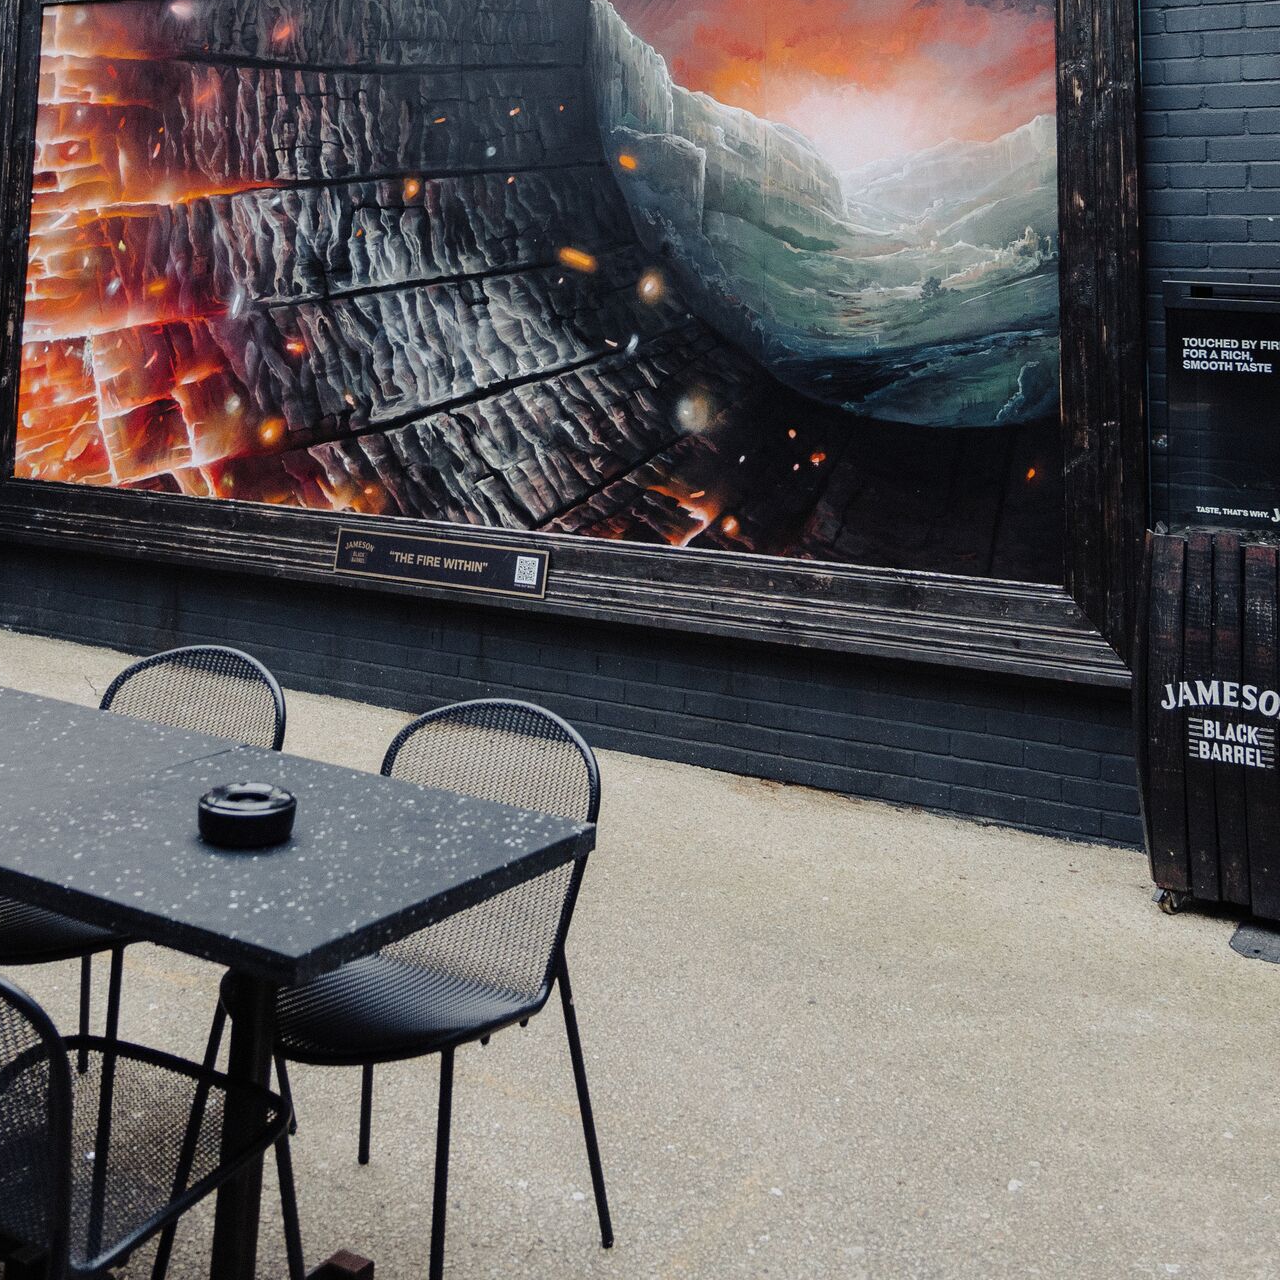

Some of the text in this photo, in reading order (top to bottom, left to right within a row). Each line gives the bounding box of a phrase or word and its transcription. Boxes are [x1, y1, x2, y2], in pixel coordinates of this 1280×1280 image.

[1182, 337, 1239, 349] TOUCHED
[1241, 339, 1258, 350] BY
[1182, 348, 1253, 362] FOR A RICH,
[1182, 359, 1272, 373] SMOOTH TASTE
[1196, 505, 1270, 519] TASTE, THAT'S WHY.
[344, 540, 375, 553] JAMESON
[416, 554, 442, 568] FIRE
[1203, 719, 1260, 746] BLACK
[1199, 741, 1266, 769] BARREL
